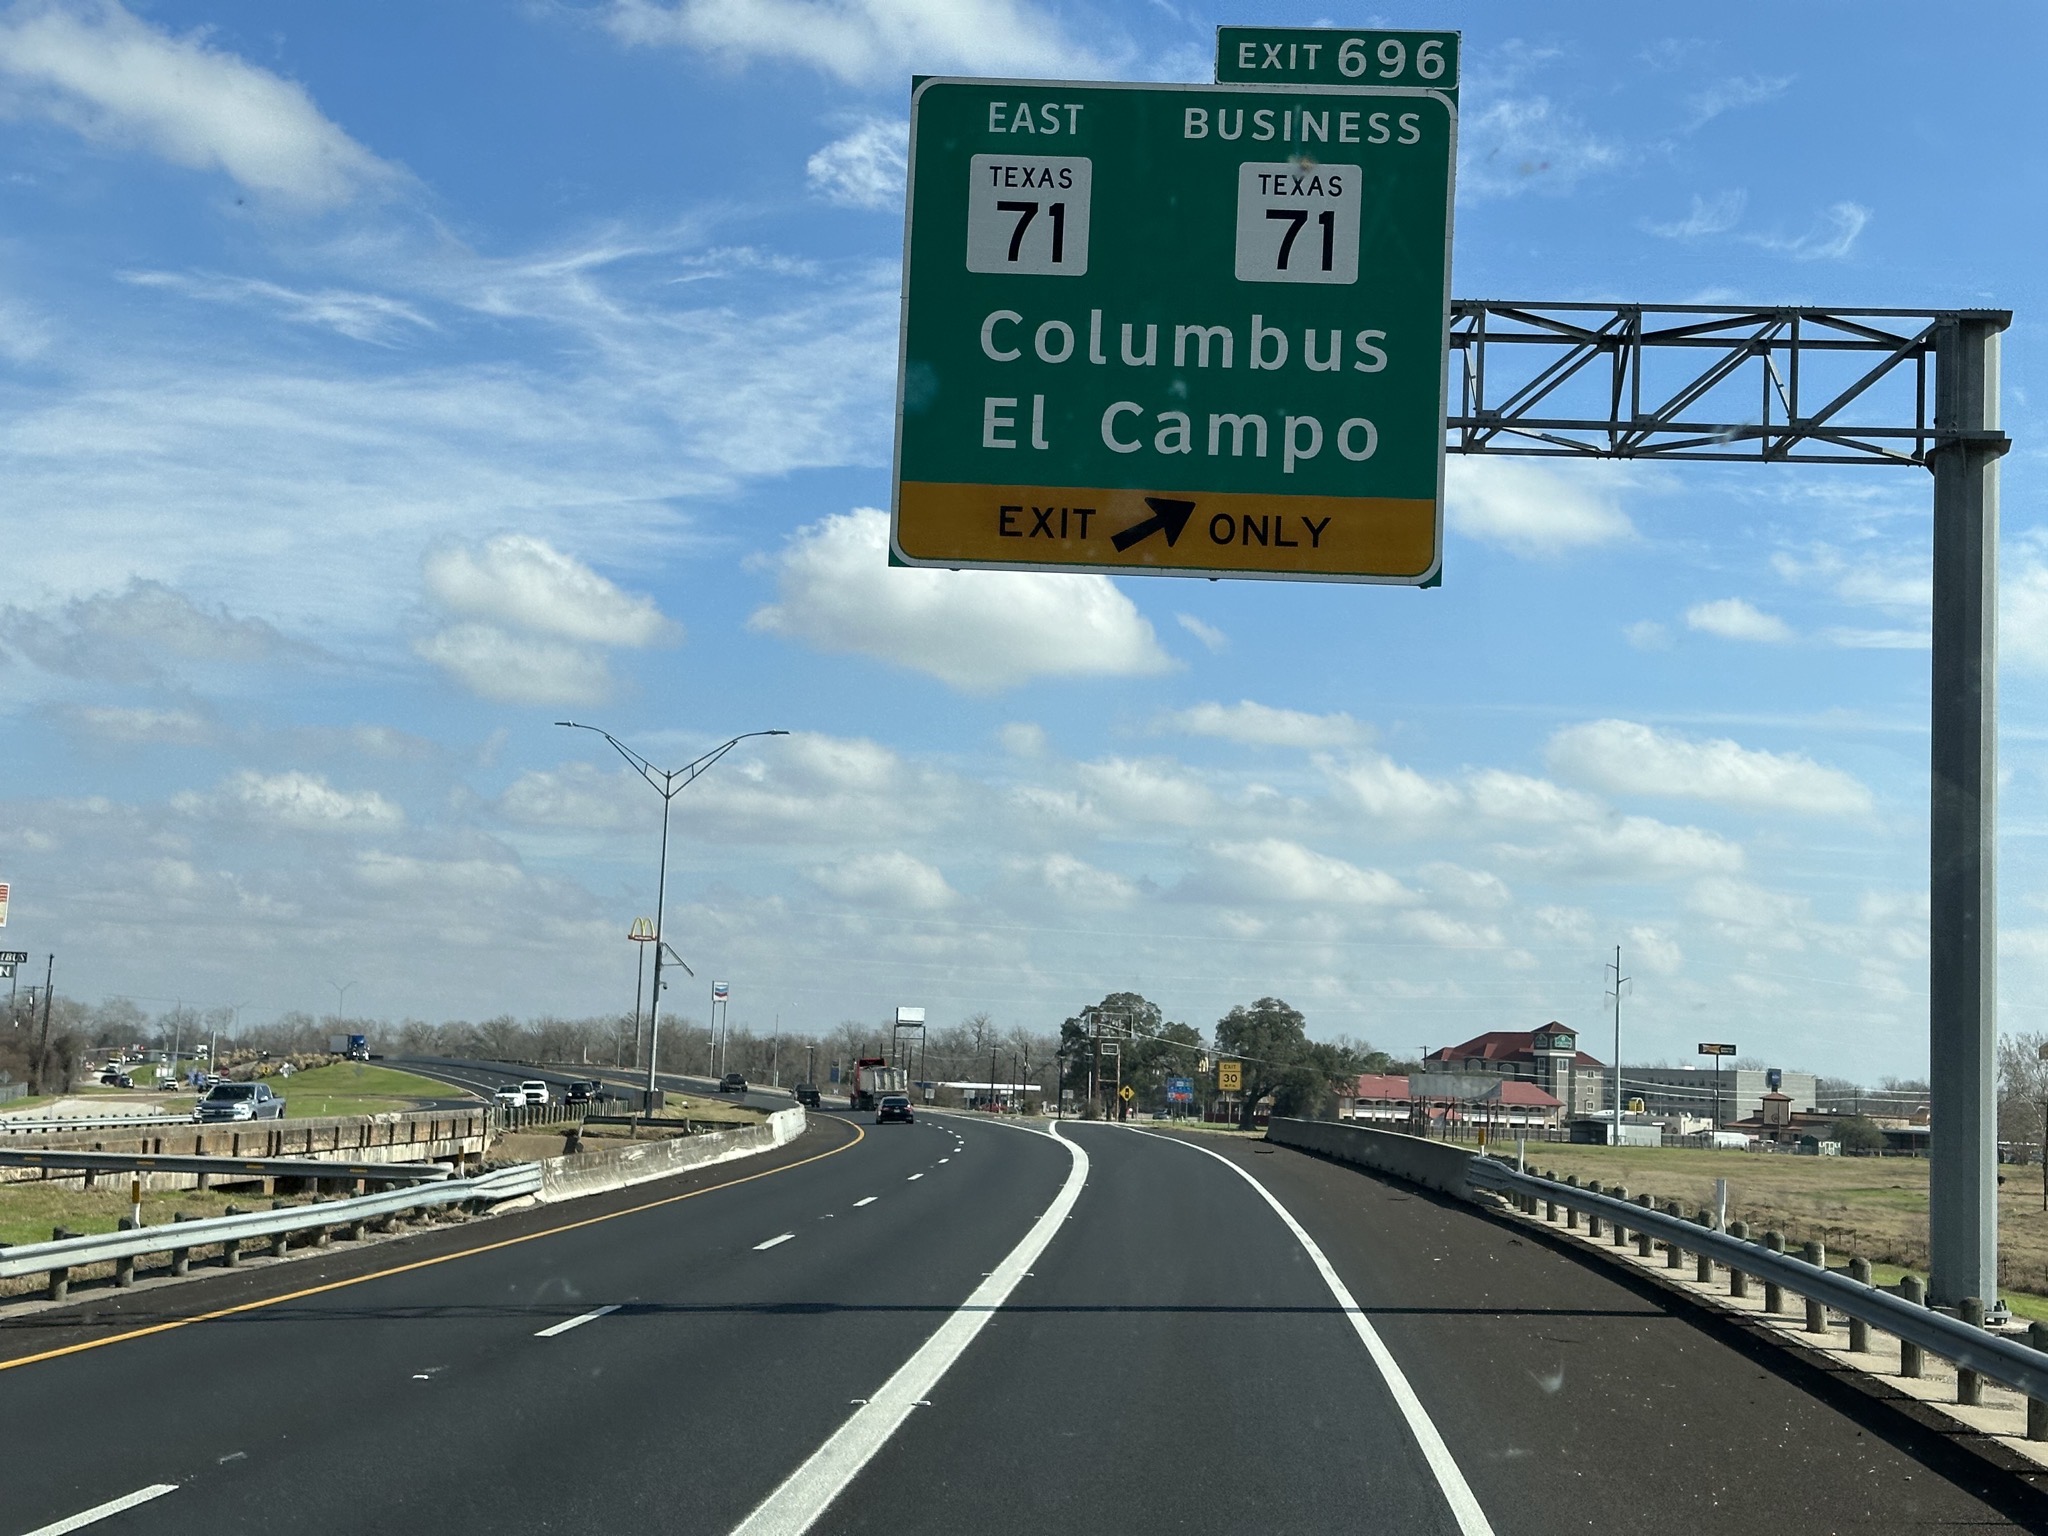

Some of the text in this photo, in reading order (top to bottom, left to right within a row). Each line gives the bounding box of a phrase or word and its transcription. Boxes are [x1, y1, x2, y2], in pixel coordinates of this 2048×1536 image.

[1237, 38, 1446, 80] EXIT 696
[988, 102, 1085, 135] EAST
[1184, 107, 1421, 145] BUSINESS
[988, 165, 1073, 190] TEXAS
[1257, 173, 1343, 198] TEXAS
[996, 200, 1066, 264] 71
[1265, 208, 1336, 272] 71
[980, 309, 1389, 373] Columbus
[982, 394, 1379, 474] El Campo
[998, 504, 1332, 549] EXIT ONLY
[1223, 1073, 1238, 1083] 30
